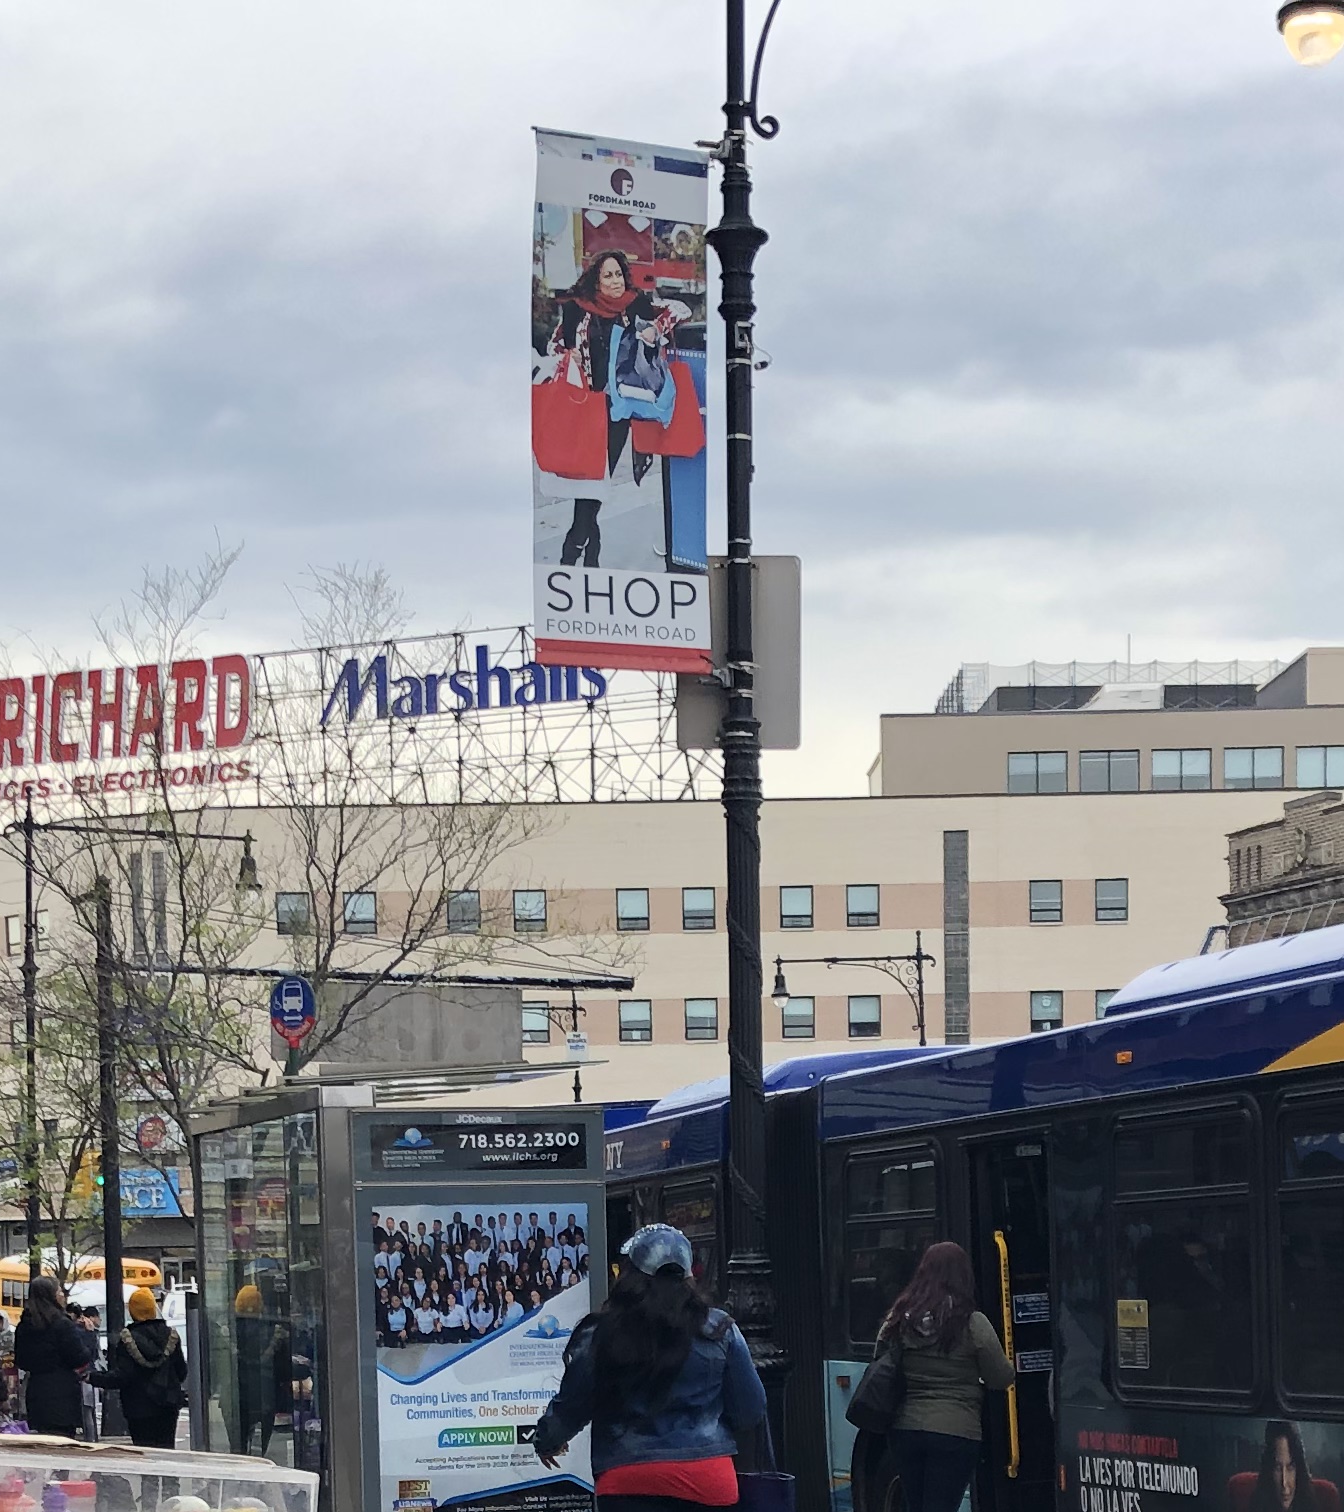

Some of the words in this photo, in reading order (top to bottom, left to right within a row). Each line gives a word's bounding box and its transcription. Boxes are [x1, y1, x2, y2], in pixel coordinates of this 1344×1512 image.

[588, 193, 631, 206] FORDHAM
[632, 200, 656, 210] ROAD
[546, 571, 698, 620] SHOP
[546, 618, 639, 639] FORDHAM
[644, 624, 697, 643] ROAD
[320, 644, 608, 727] Marshalls
[73, 758, 252, 795] ELECTRONICS
[455, 1113, 503, 1125] JCDecaux
[458, 1131, 580, 1149] 718.562.2300
[605, 1140, 624, 1171] NY
[390, 1393, 438, 1407] Changing
[441, 1391, 468, 1404] Lives
[470, 1389, 489, 1402] and
[491, 1387, 557, 1401] Transforming
[406, 1406, 477, 1420] Communities,
[478, 1406, 498, 1418] One
[501, 1404, 539, 1417] Scholar
[442, 1432, 477, 1445] APPLY
[479, 1430, 513, 1443] NOW!
[1079, 1455, 1092, 1484] LA
[1092, 1457, 1113, 1486] VES
[1114, 1459, 1136, 1489] POR
[1136, 1461, 1199, 1497] TELEMUNDO
[1080, 1485, 1088, 1512] O
